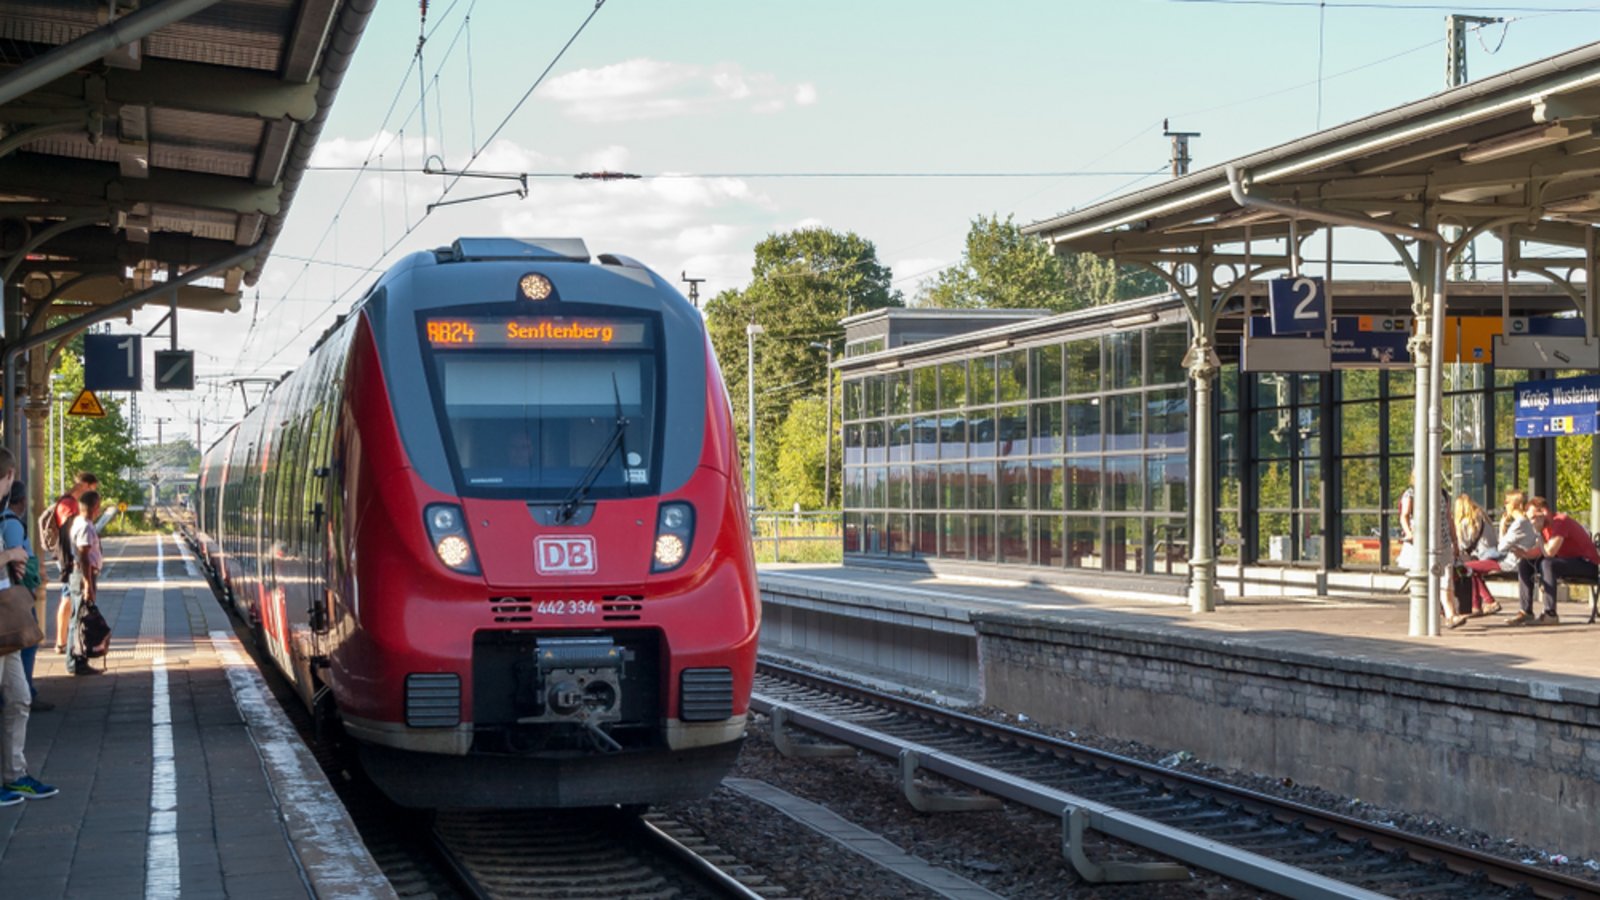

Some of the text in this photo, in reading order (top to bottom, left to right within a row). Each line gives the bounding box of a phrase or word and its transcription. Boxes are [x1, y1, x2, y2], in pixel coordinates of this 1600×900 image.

[1292, 278, 1320, 320] 2
[507, 321, 614, 342] Senftenberg
[117, 337, 134, 378] 1
[542, 542, 590, 568] DB
[537, 600, 597, 614] 442 334
